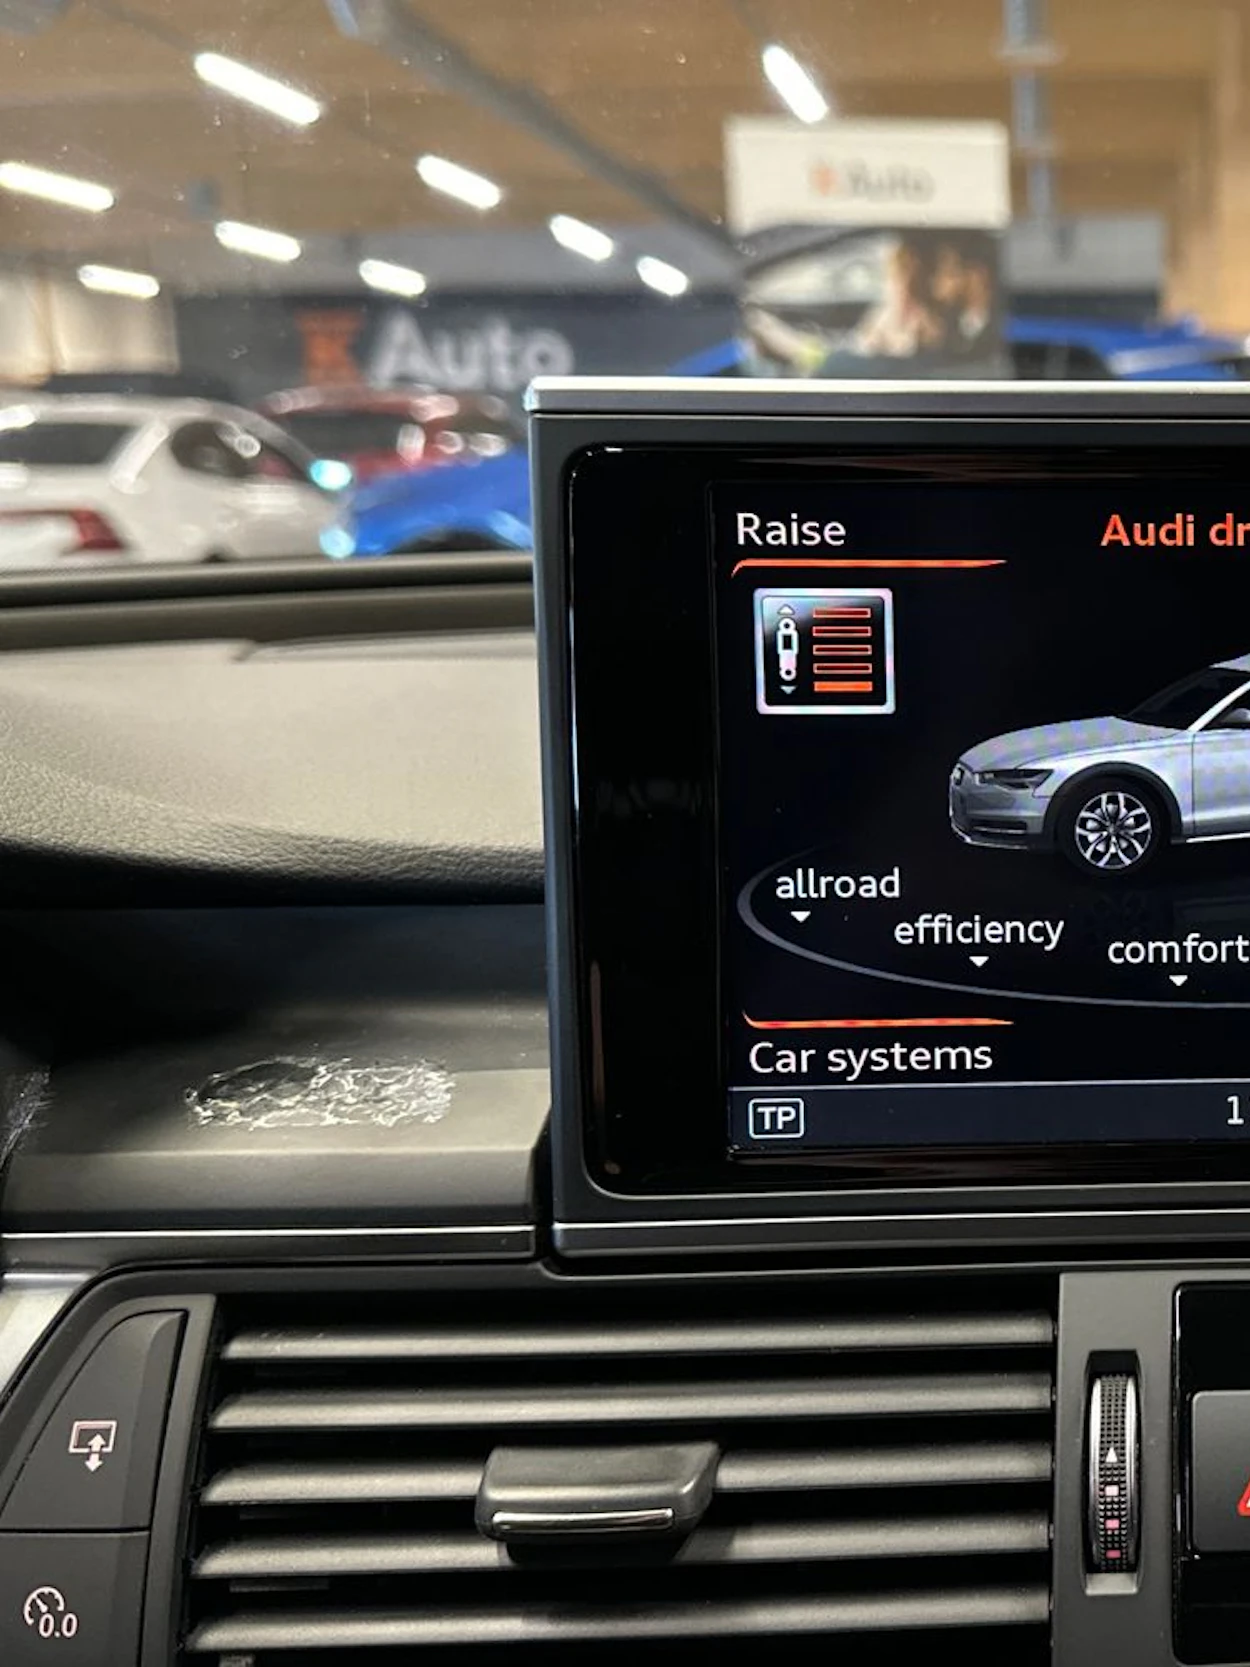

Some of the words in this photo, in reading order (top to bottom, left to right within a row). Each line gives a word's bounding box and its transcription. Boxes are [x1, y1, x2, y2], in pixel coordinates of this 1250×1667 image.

[736, 512, 847, 546] Raise
[1100, 512, 1195, 547] Audi
[775, 866, 901, 900] allroad
[893, 913, 1065, 951] efficiency
[1107, 932, 1250, 964] comfort
[749, 1041, 816, 1074] Car
[827, 1041, 994, 1082] systems
[757, 1105, 797, 1131] TP
[39, 1612, 78, 1638] 0.0
